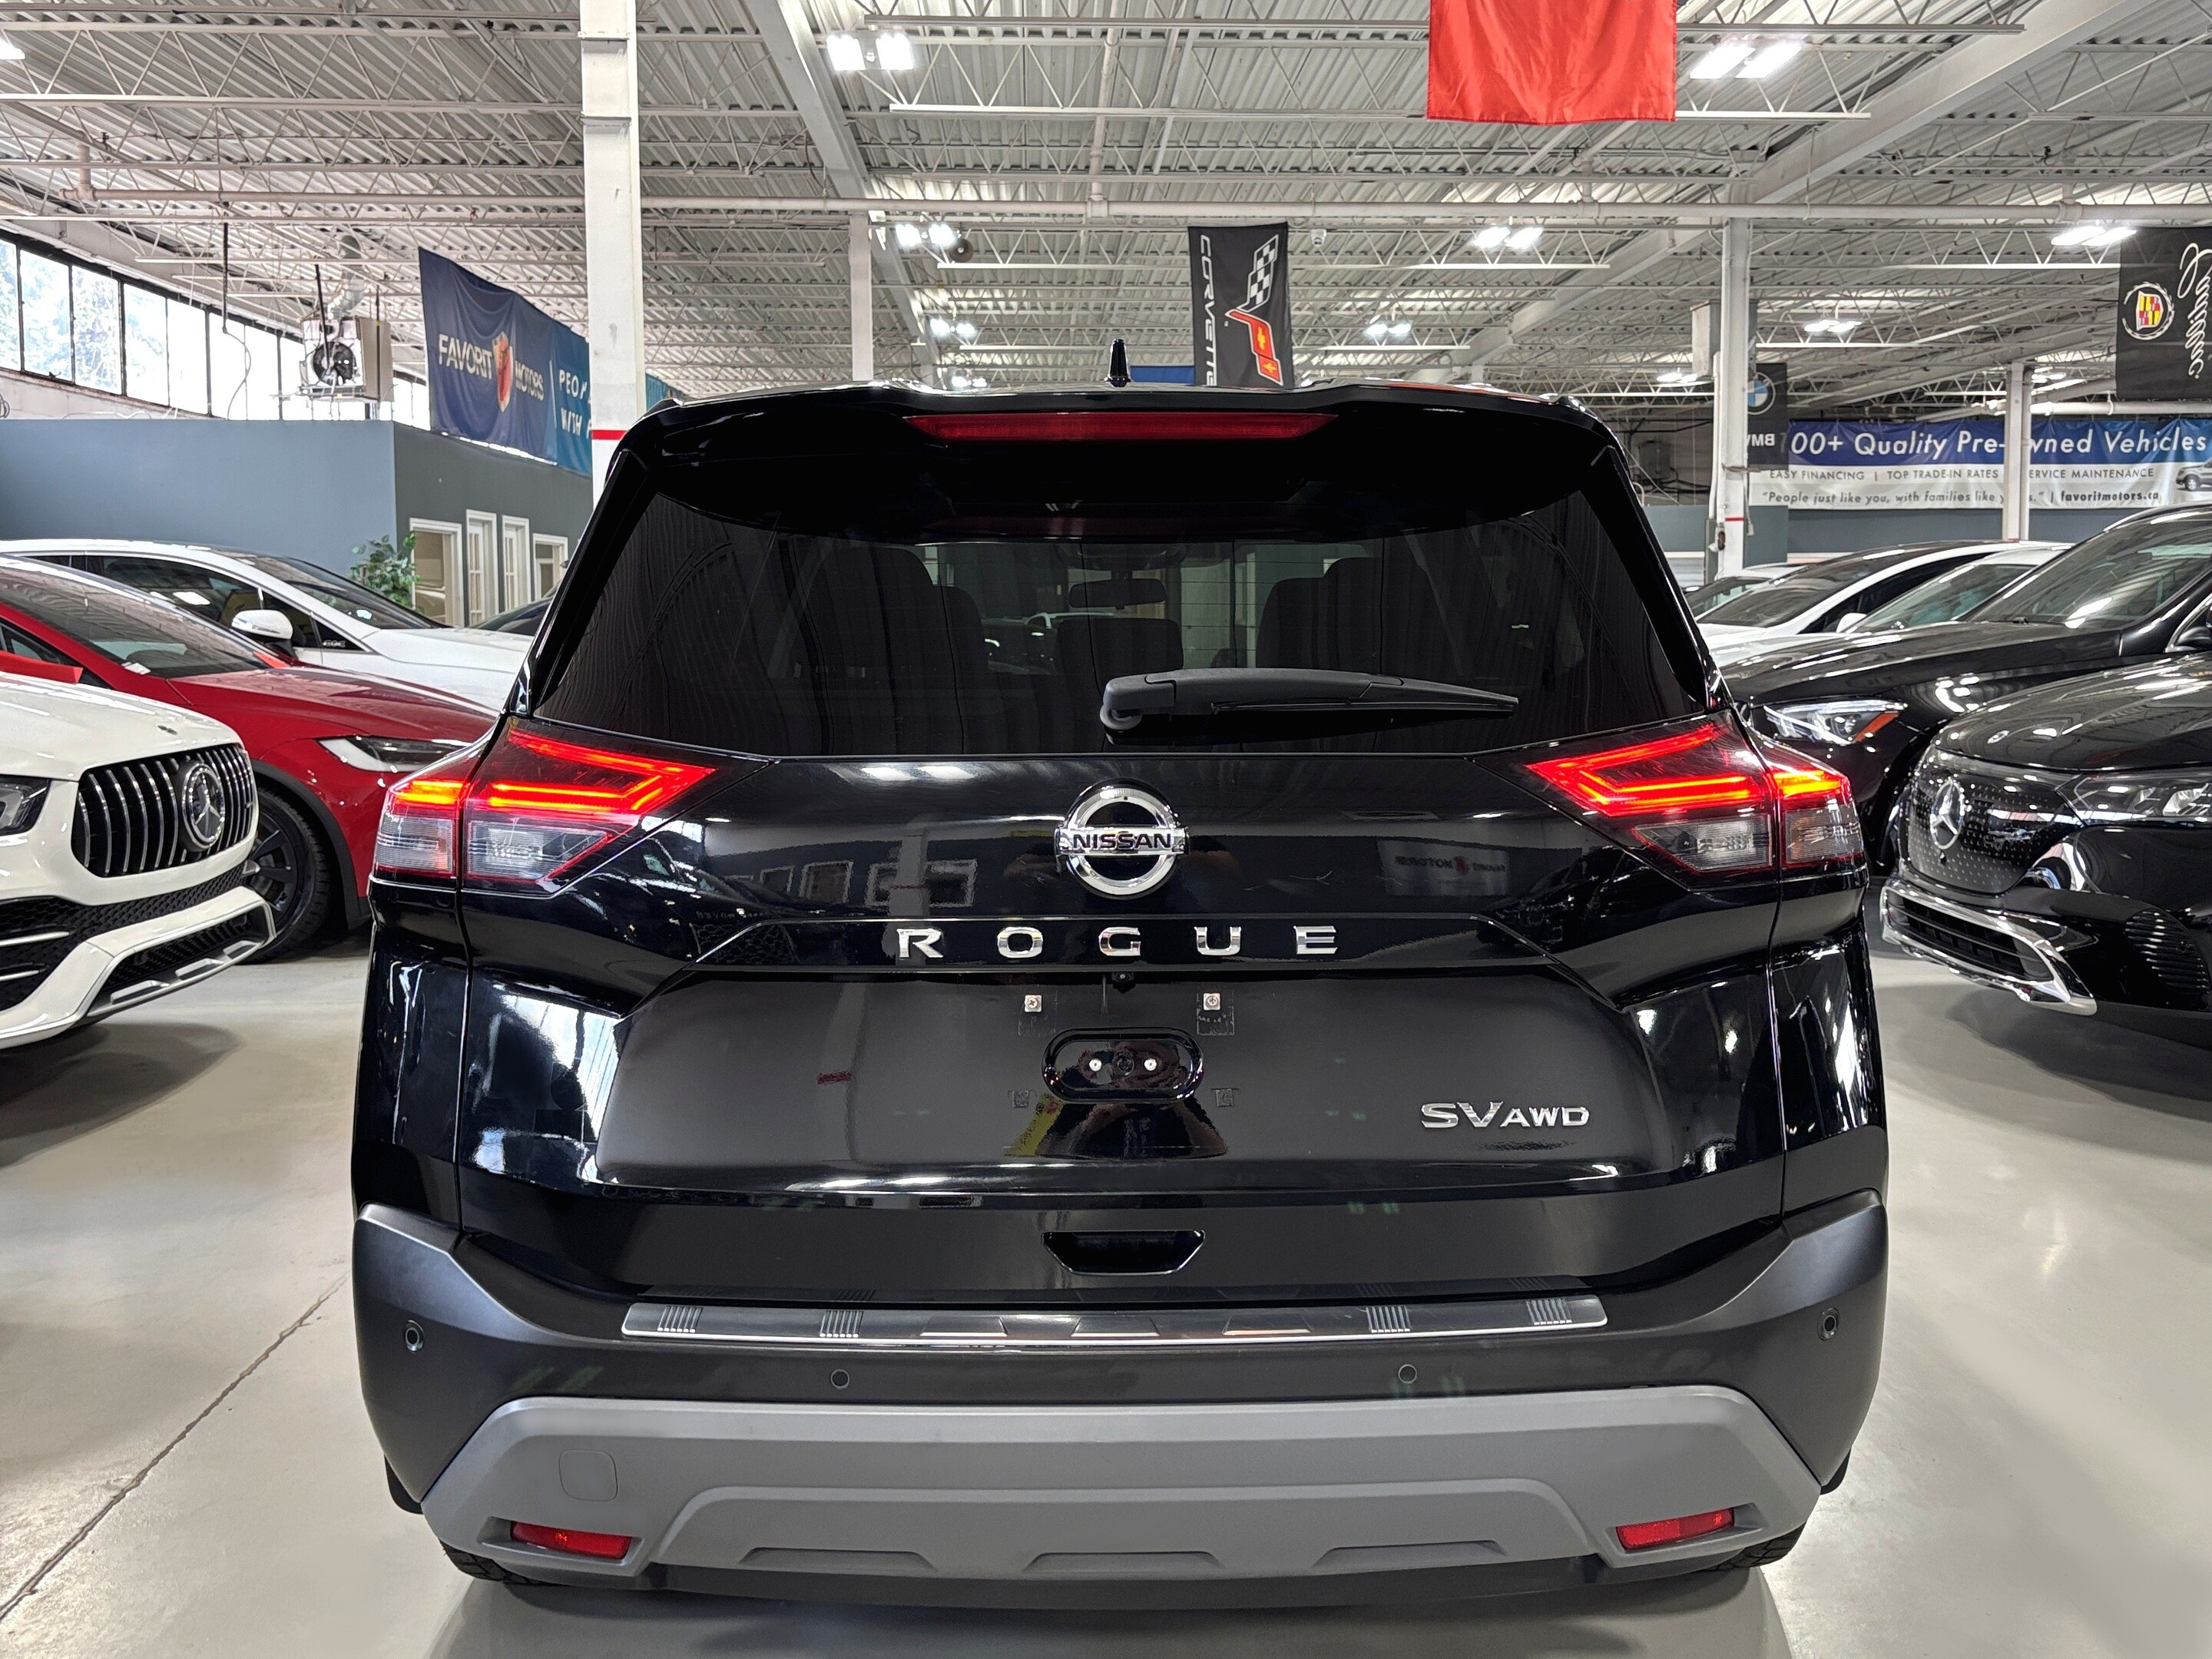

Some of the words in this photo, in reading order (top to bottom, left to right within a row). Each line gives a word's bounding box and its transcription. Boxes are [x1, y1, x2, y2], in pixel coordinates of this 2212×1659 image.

[1200, 234, 1217, 386] CORVETTE
[439, 333, 492, 380] FAVORIT
[515, 359, 545, 402] MOTORS
[561, 407, 583, 436] WITH
[1854, 430, 1948, 460] Quality
[2104, 426, 2207, 453] Vehicles
[1770, 469, 1797, 479] EASY
[1801, 470, 1865, 480] FINANCING
[1886, 471, 1909, 480] TOP
[1913, 470, 1962, 479] TRADE-IN
[1966, 469, 1998, 478] RATES
[2028, 469, 2066, 478] ERVICE
[2071, 468, 2154, 479] MAINTENANCE
[1813, 492, 1836, 504] just
[1839, 492, 1861, 503] like
[1866, 494, 1890, 505] you,
[1895, 492, 1919, 502] with
[1924, 490, 1970, 503] families
[1975, 490, 1995, 502] like
[2061, 490, 2159, 502] favoritmotors.ca
[1073, 833, 1171, 849] NISSAN
[896, 924, 1338, 959] ROGUE
